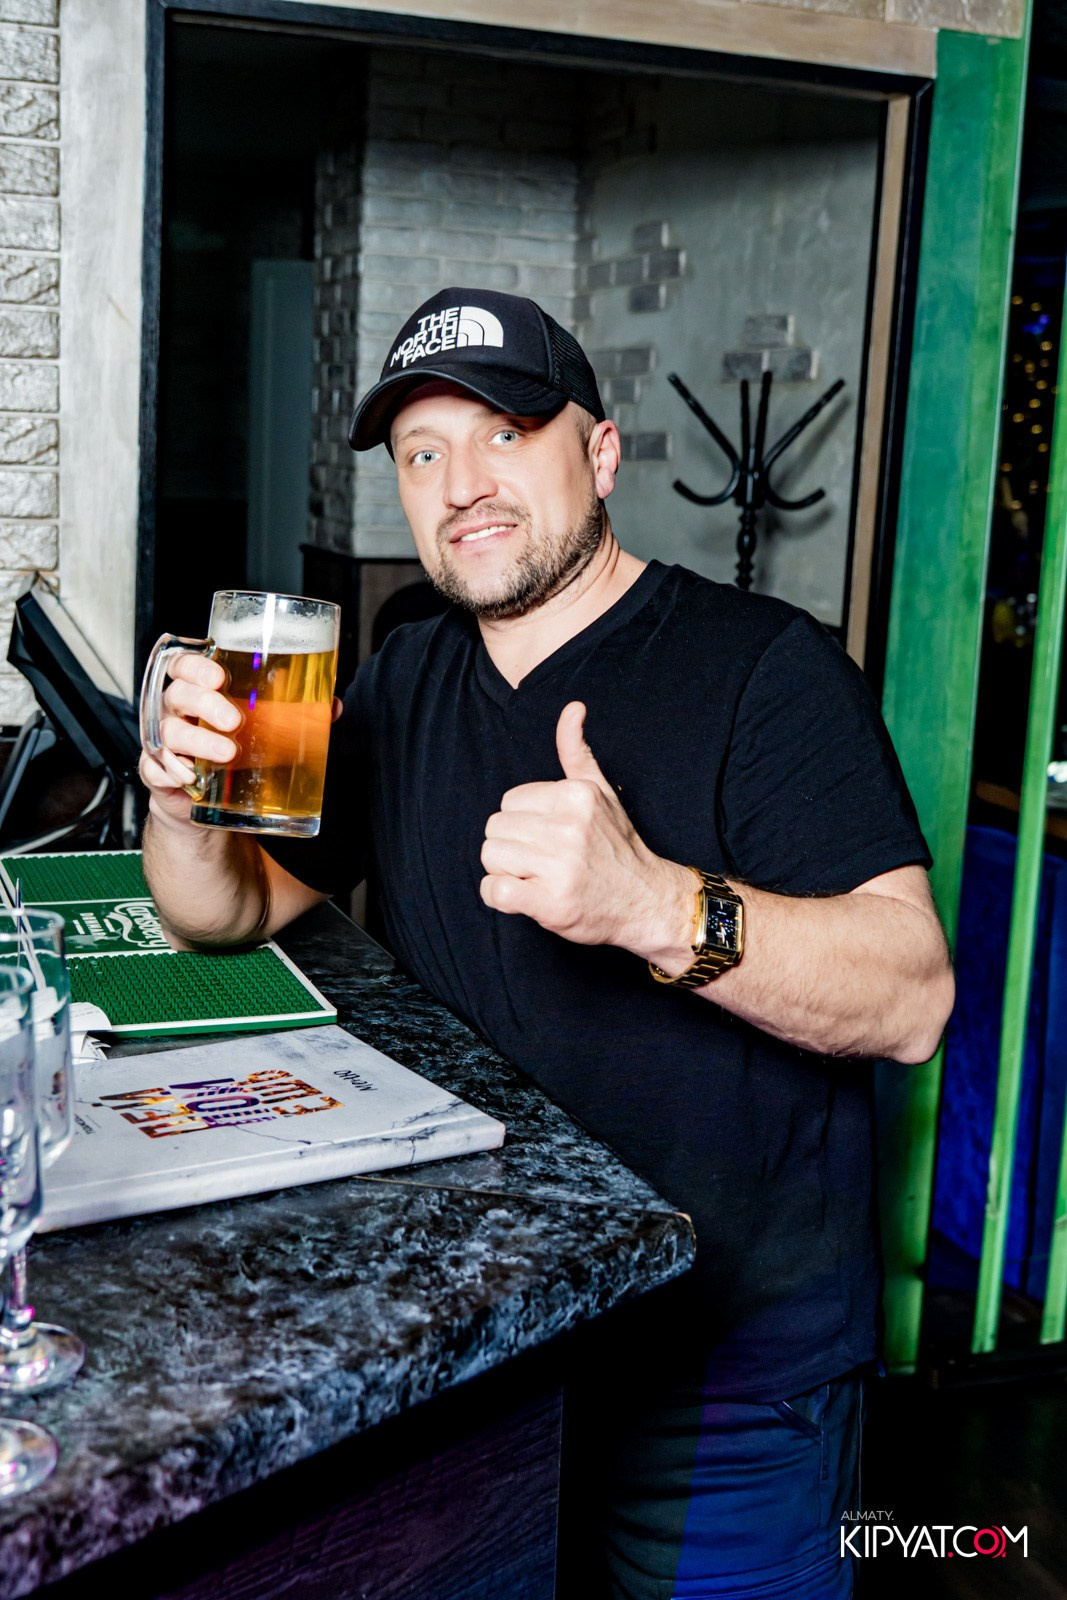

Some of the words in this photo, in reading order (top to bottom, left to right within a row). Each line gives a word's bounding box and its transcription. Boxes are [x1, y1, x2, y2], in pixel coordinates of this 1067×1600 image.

[390, 317, 459, 368] NORTH
[418, 306, 460, 332] THE
[402, 337, 456, 368] FACE
[91, 1087, 208, 1139] ПЕЙ
[160, 1077, 276, 1129] ПОЙ
[231, 1069, 345, 1116] ЕШЬ
